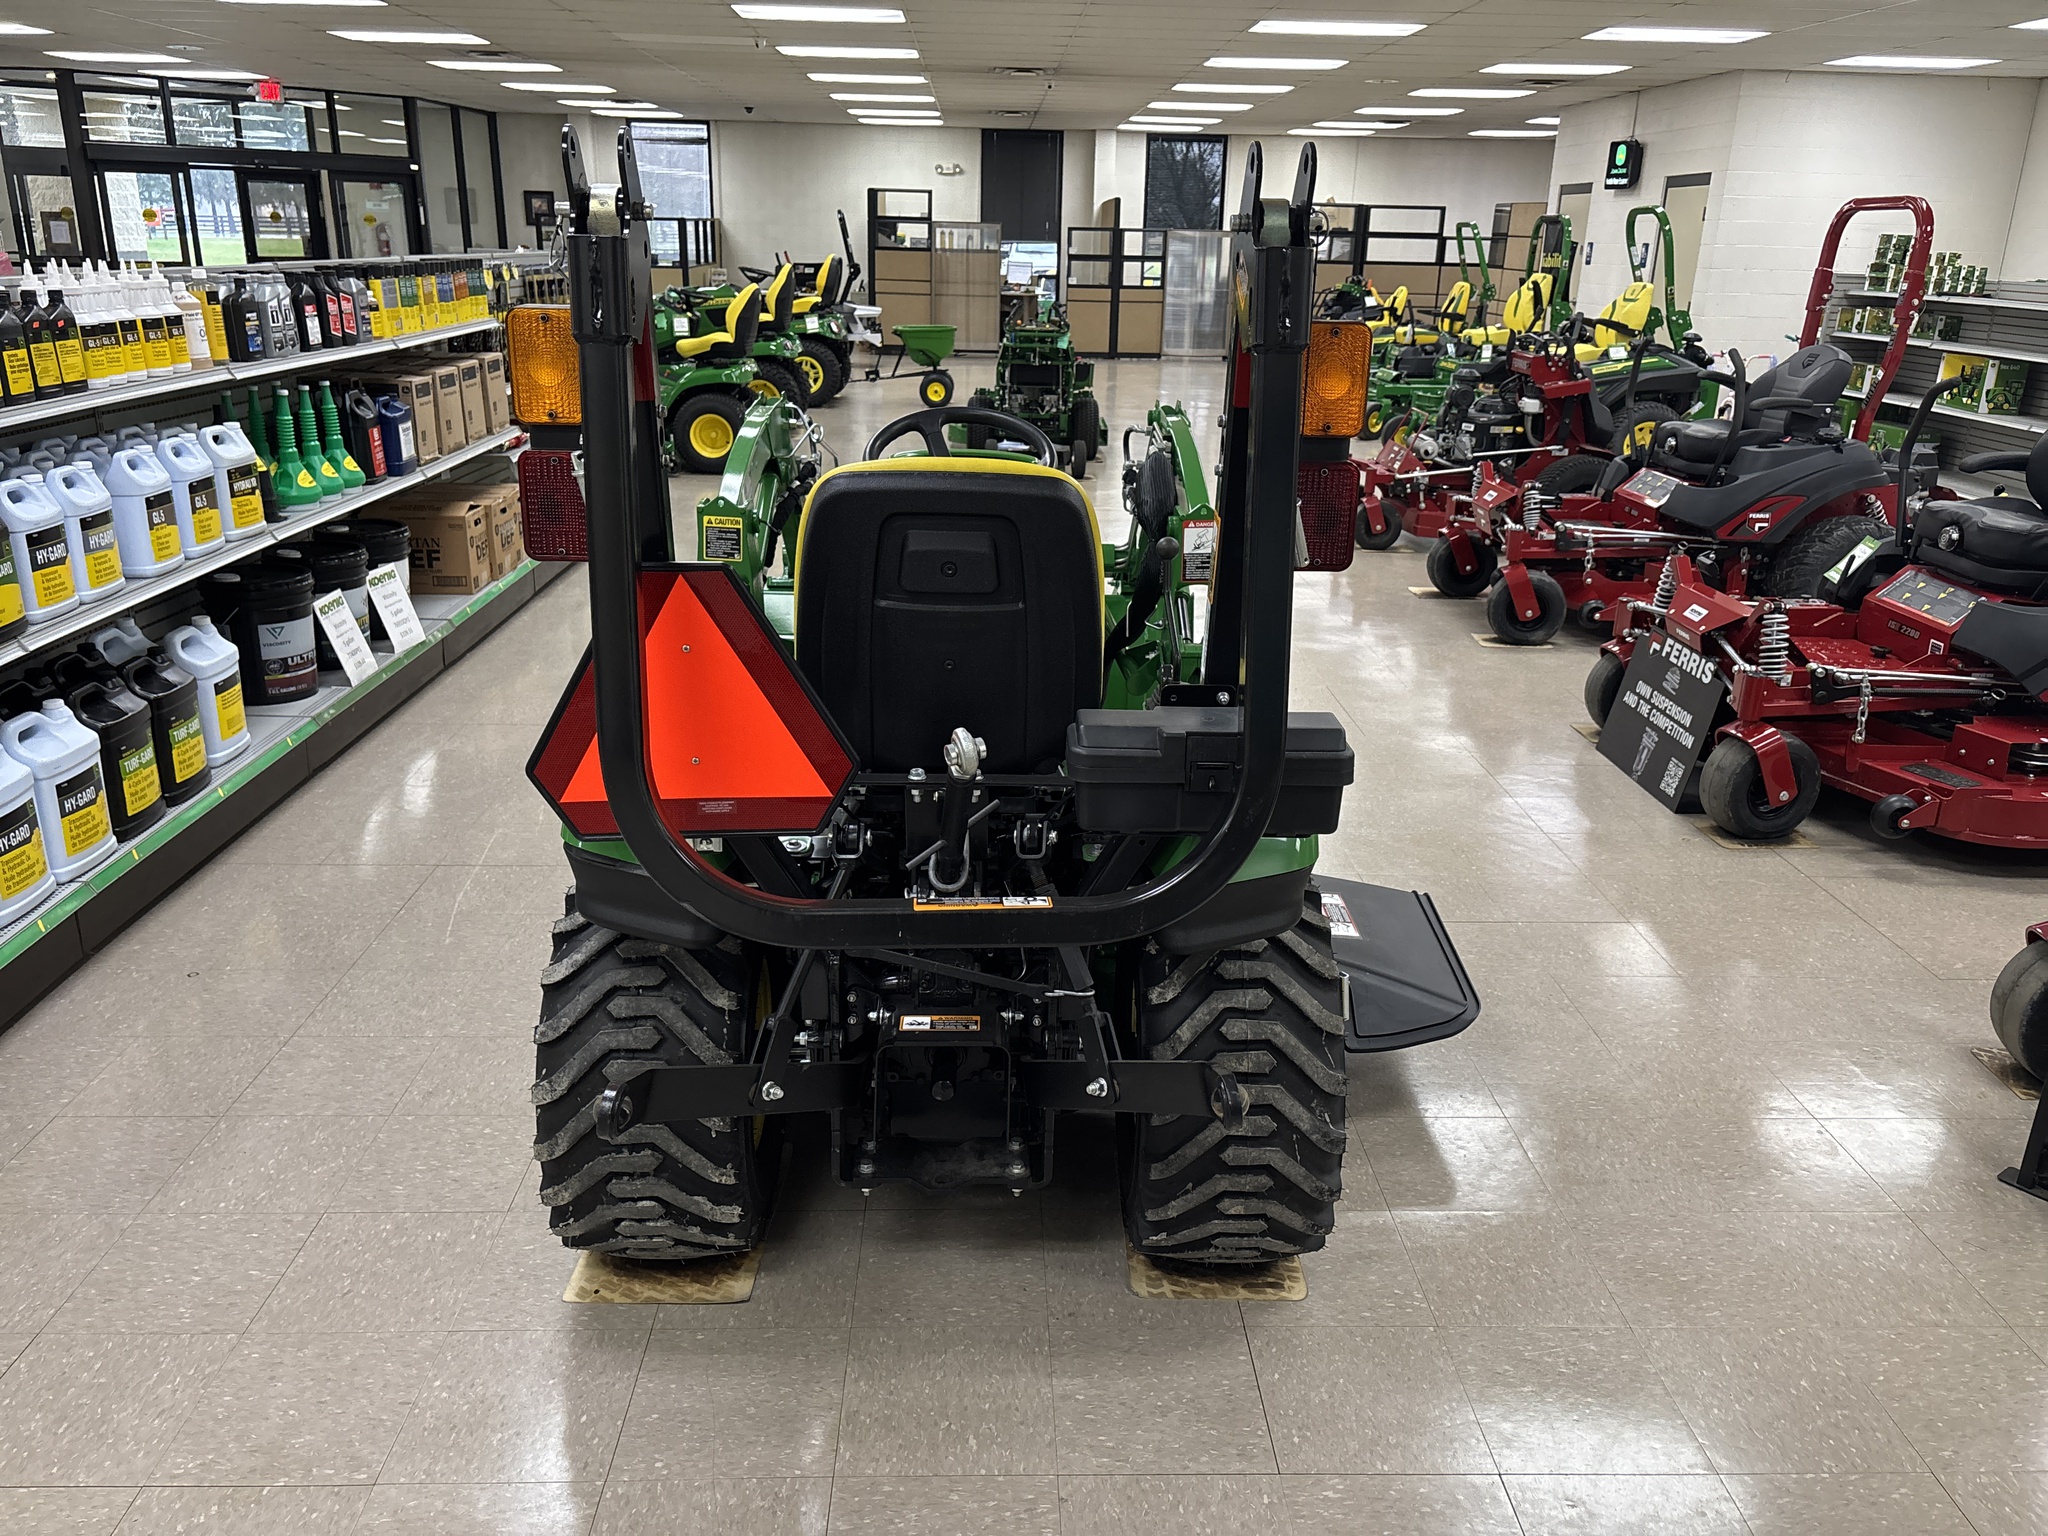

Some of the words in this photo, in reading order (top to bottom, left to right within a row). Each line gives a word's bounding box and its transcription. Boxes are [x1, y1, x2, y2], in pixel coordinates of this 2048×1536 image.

[88, 340, 100, 348] GL-5
[103, 336, 116, 345] GL-5
[149, 331, 161, 339] GL-5
[194, 495, 207, 508] GL-5
[152, 510, 165, 523] GL-5
[714, 518, 741, 526] CAUTION
[88, 529, 114, 550] HY-GARD
[36, 543, 67, 565] HY-GARD
[410, 549, 441, 568] EF
[1662, 637, 1714, 684] FERRIS
[1636, 681, 1651, 699] OWN
[1651, 691, 1693, 728] SUSPENSION
[173, 718, 200, 742] TURF-GARD
[1623, 691, 1638, 708] AND
[1637, 700, 1652, 718] THE
[1649, 709, 1695, 749] COMPETITION
[124, 747, 154, 773] TURF-GARD
[64, 786, 96, 813] HY-GARD
